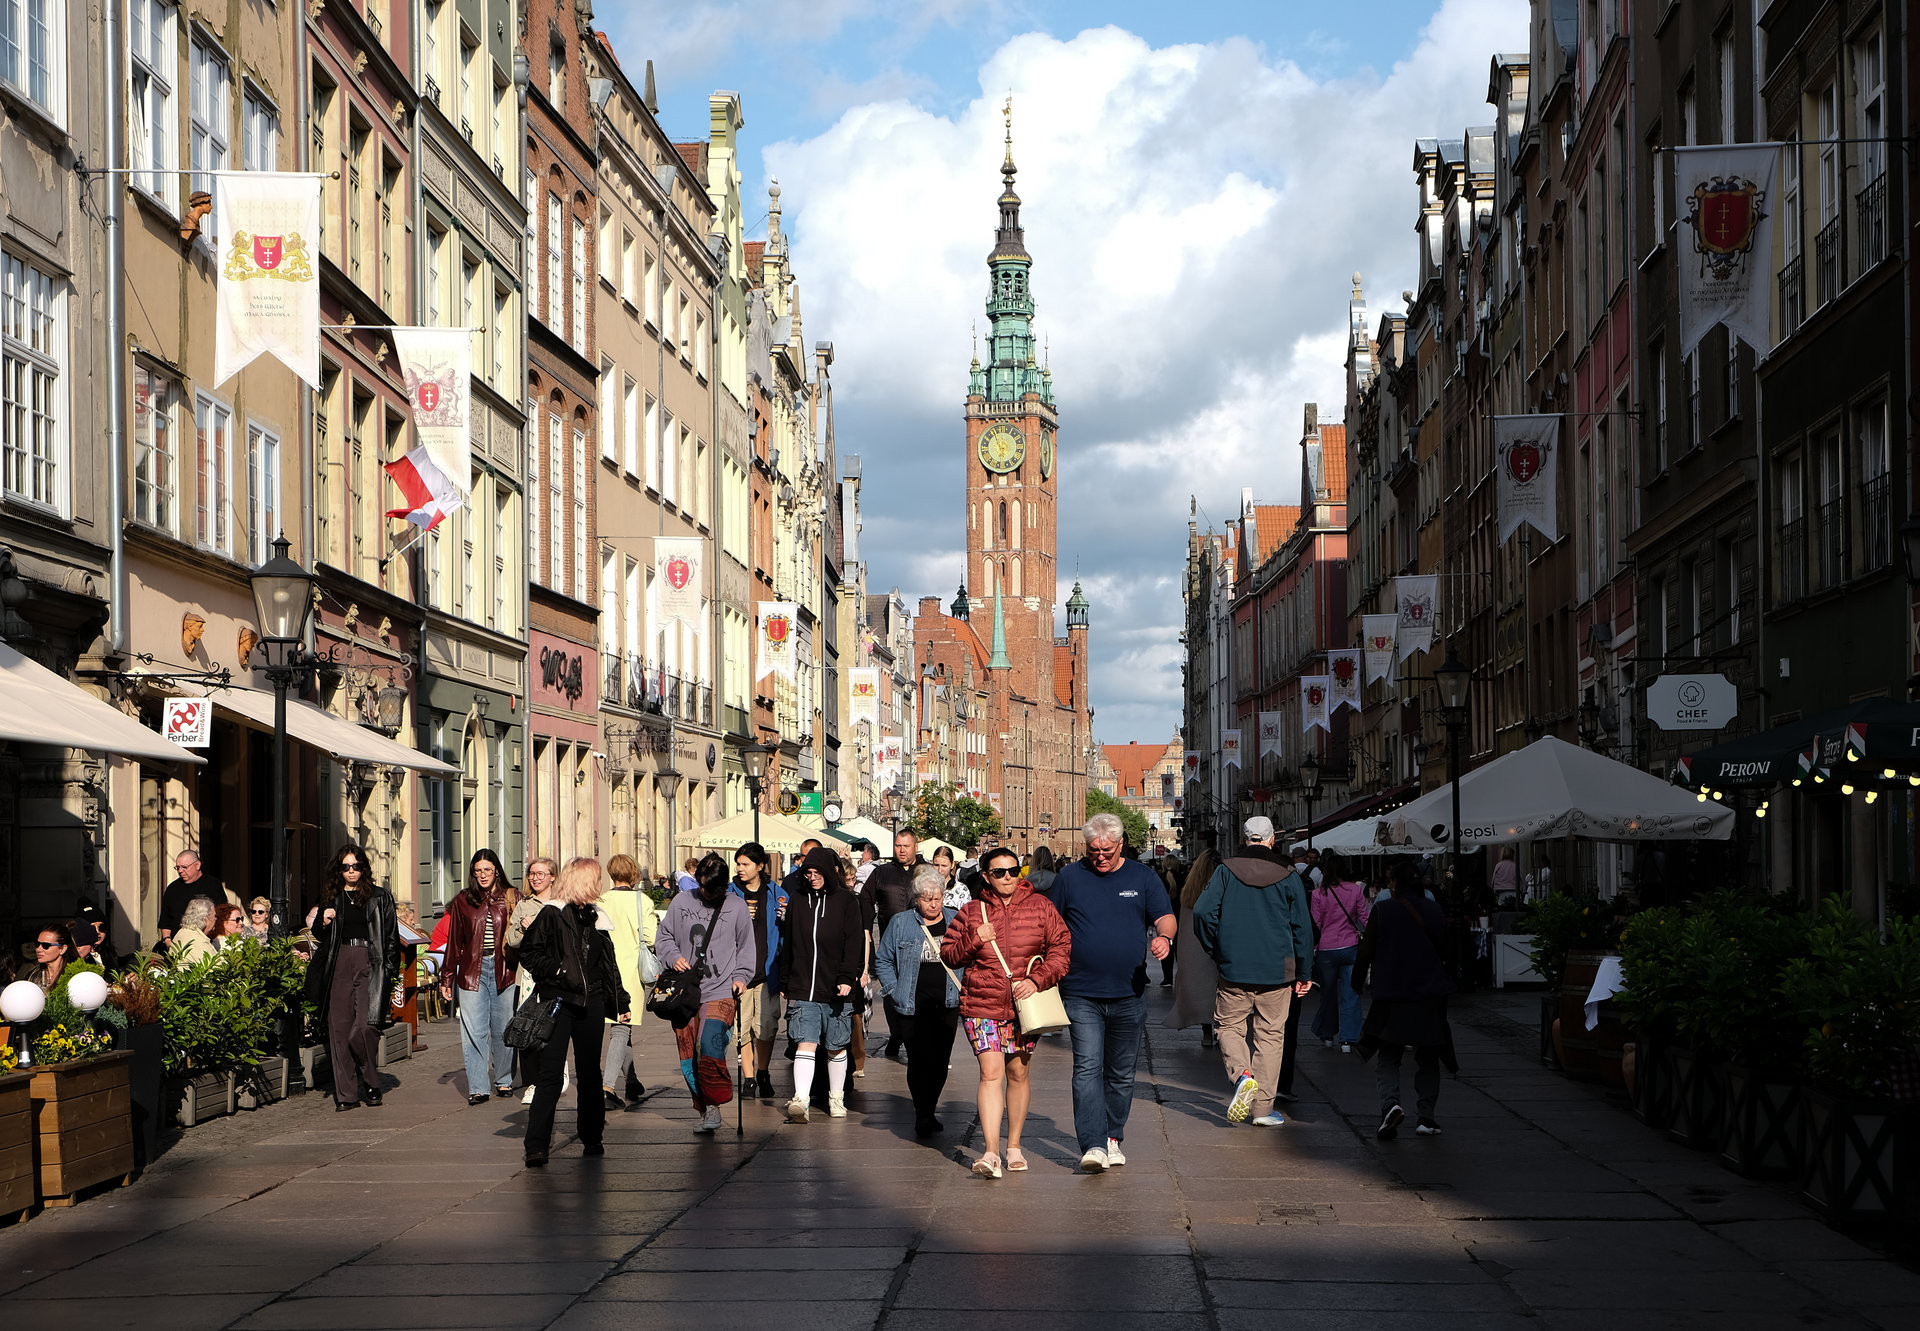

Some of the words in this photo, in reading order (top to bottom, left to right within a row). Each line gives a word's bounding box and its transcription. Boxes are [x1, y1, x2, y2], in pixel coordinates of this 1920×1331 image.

[1677, 709, 1708, 718] CHEF
[168, 733, 198, 742] Ferber
[1719, 761, 1771, 777] PERONI
